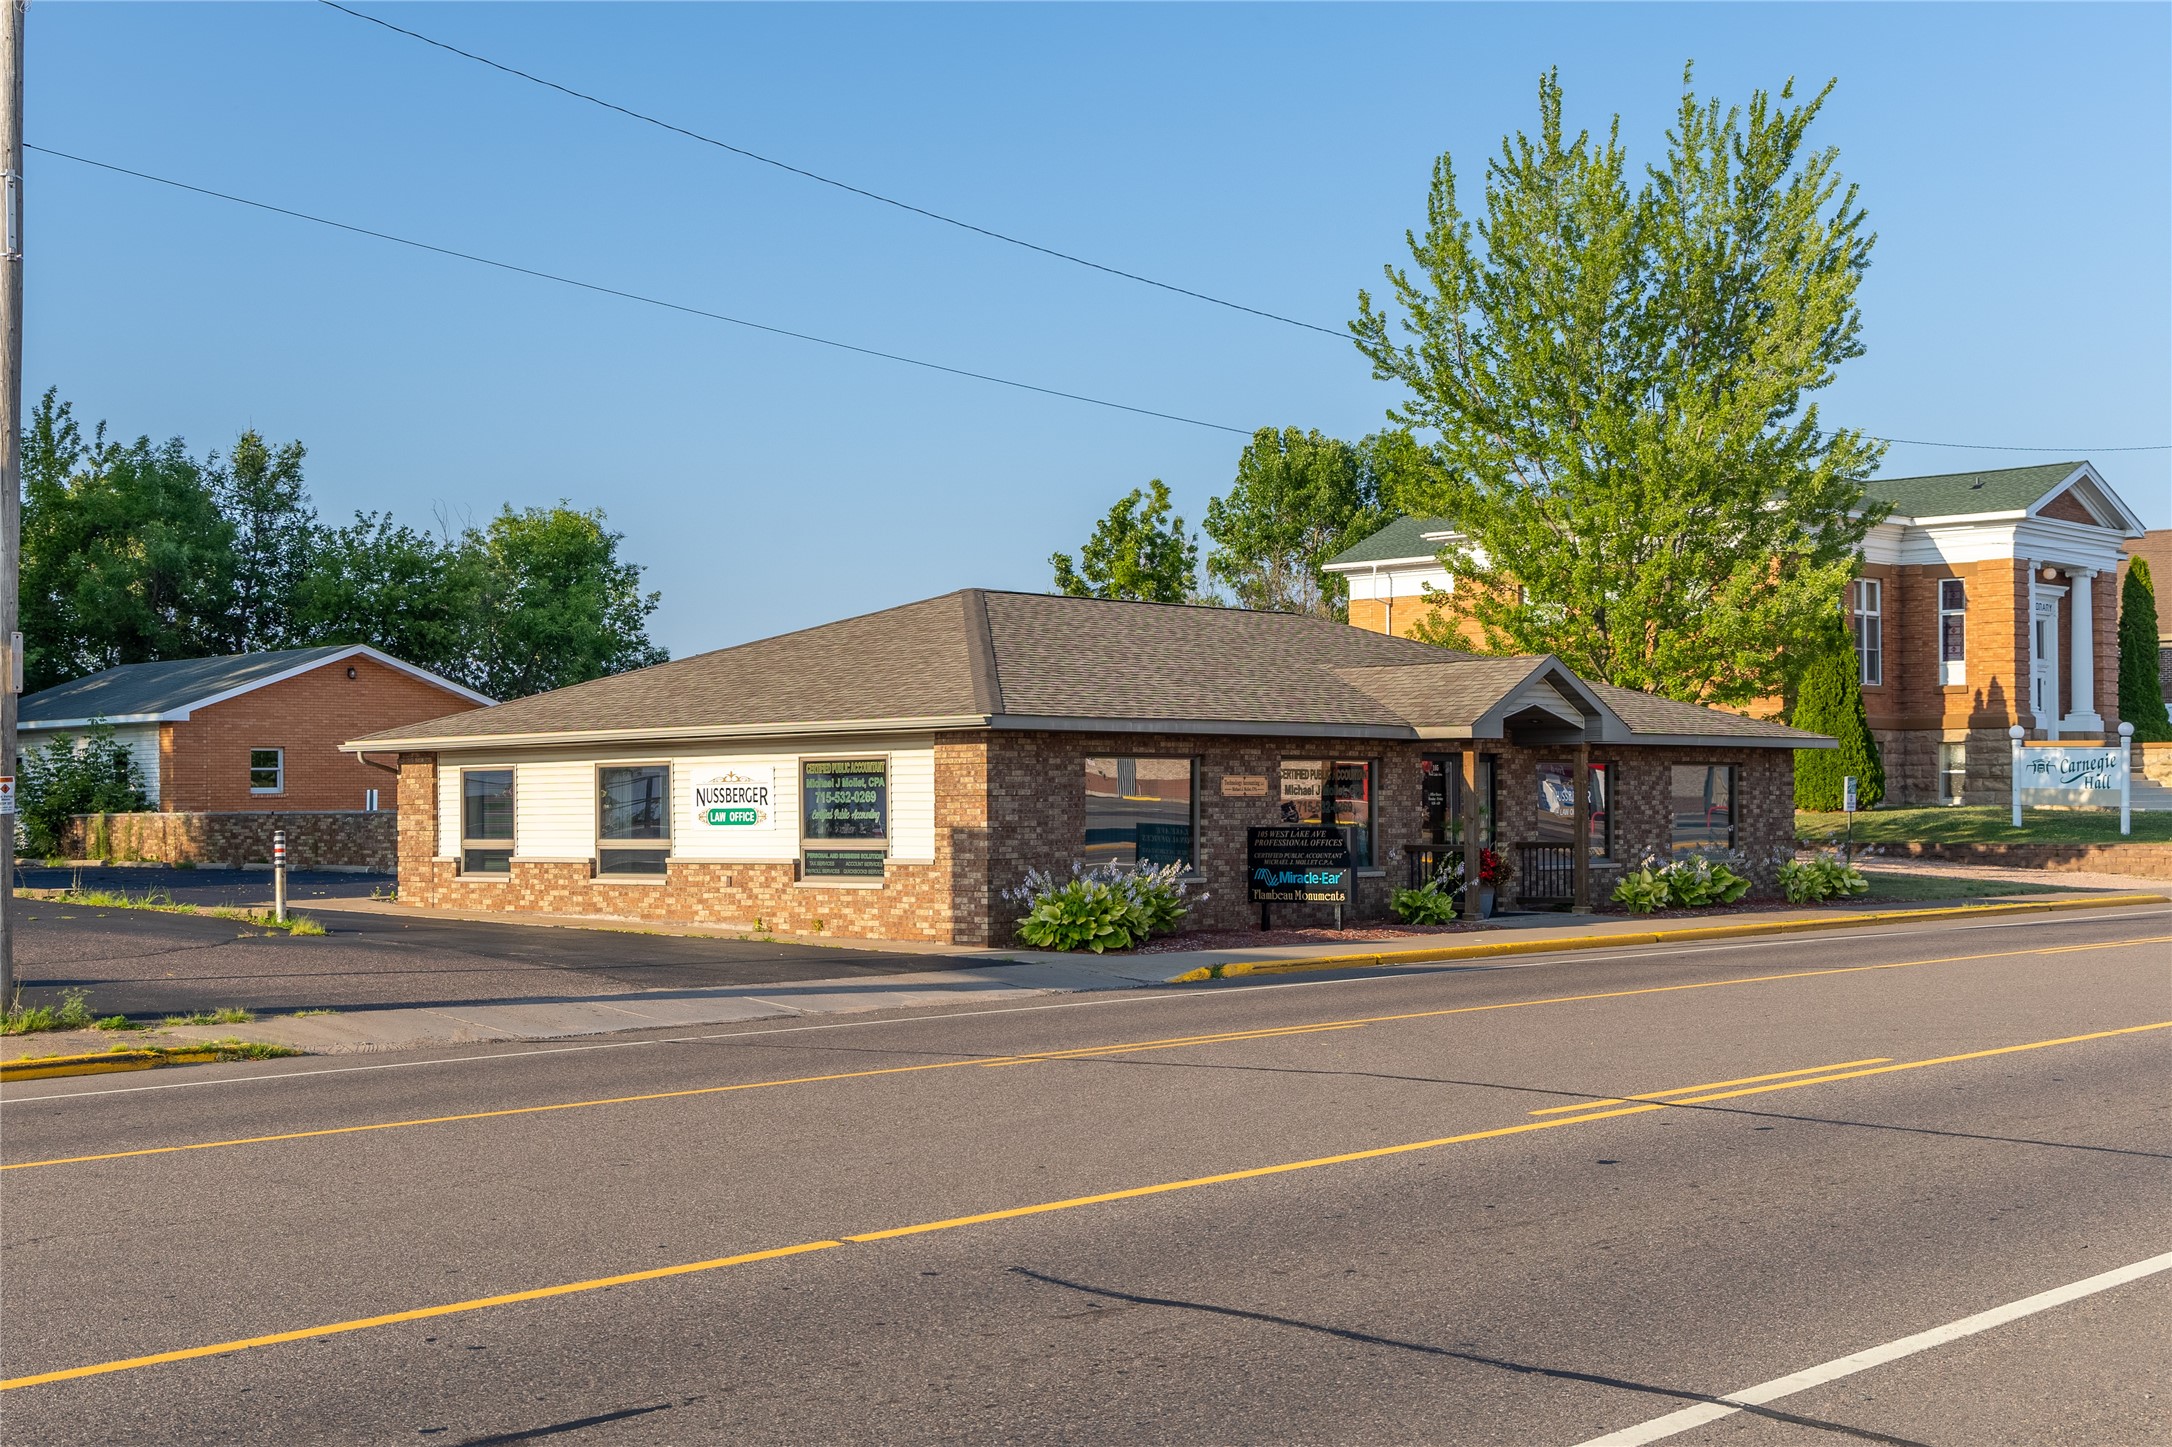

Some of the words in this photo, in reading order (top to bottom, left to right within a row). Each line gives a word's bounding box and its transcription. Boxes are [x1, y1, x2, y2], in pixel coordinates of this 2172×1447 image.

[806, 763, 832, 774] CERTIFIED
[832, 762, 850, 773] PUBLIC
[2060, 753, 2117, 776] Carnegie
[806, 779, 834, 788] Michael
[835, 778, 841, 788] J
[868, 777, 885, 787] CPA
[2084, 774, 2112, 790] Hall
[1284, 784, 1314, 796] Michael
[1315, 785, 1320, 796] J
[696, 787, 768, 807] NUSSBERGER
[815, 790, 877, 803] 715-532-0269
[710, 812, 726, 822] LAW
[729, 811, 755, 822] OFFICE
[811, 808, 833, 822] Certified
[833, 808, 850, 820] Public
[851, 807, 880, 823] Accounting
[1257, 830, 1268, 838] 105
[1269, 830, 1289, 838] WEST
[1290, 830, 1310, 838] LAKE
[1310, 830, 1327, 838] AVE
[1254, 839, 1309, 847] PROFESSIONAL
[1310, 839, 1344, 847] OFFICES
[1252, 888, 1293, 901] Flambeau
[1294, 889, 1346, 902] Monuments
